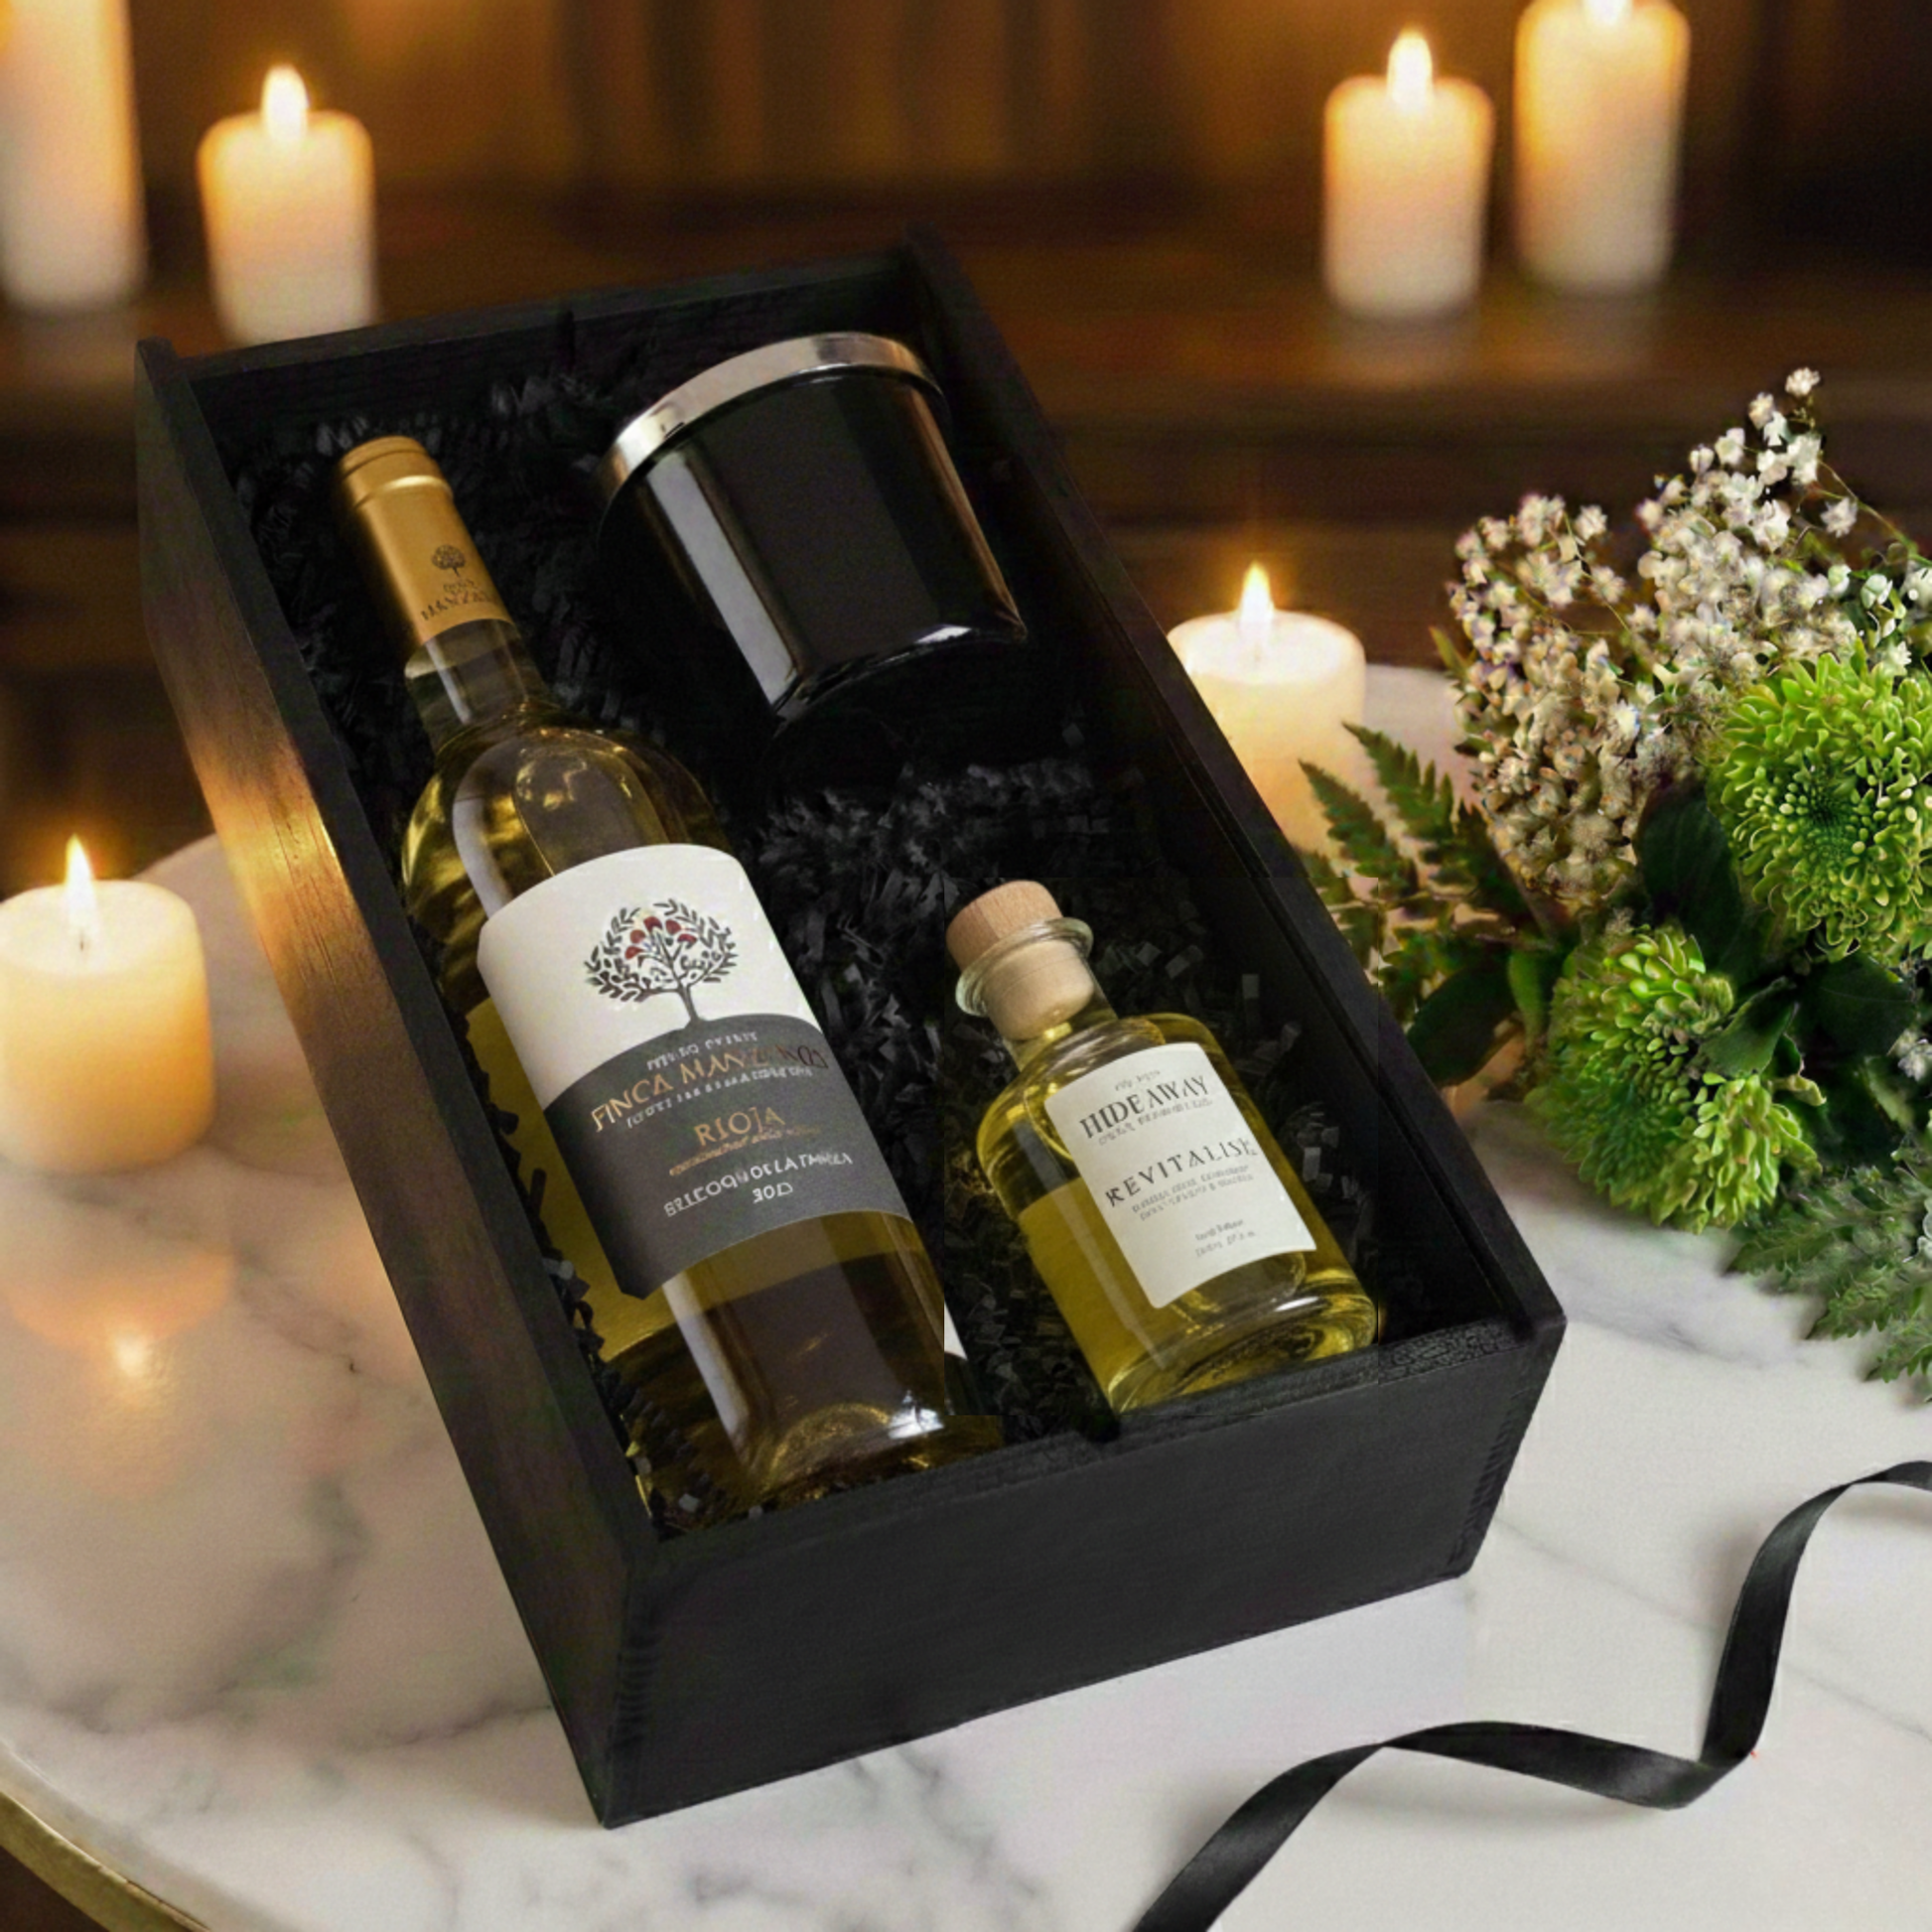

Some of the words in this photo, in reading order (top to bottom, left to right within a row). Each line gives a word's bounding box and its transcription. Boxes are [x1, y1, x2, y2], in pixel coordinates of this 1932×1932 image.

[591, 1073, 674, 1132] FINCA
[693, 1106, 786, 1147] RIOJA
[1079, 1074, 1209, 1139] HIDEAWAY
[1104, 1136, 1258, 1207] REVITALISE
